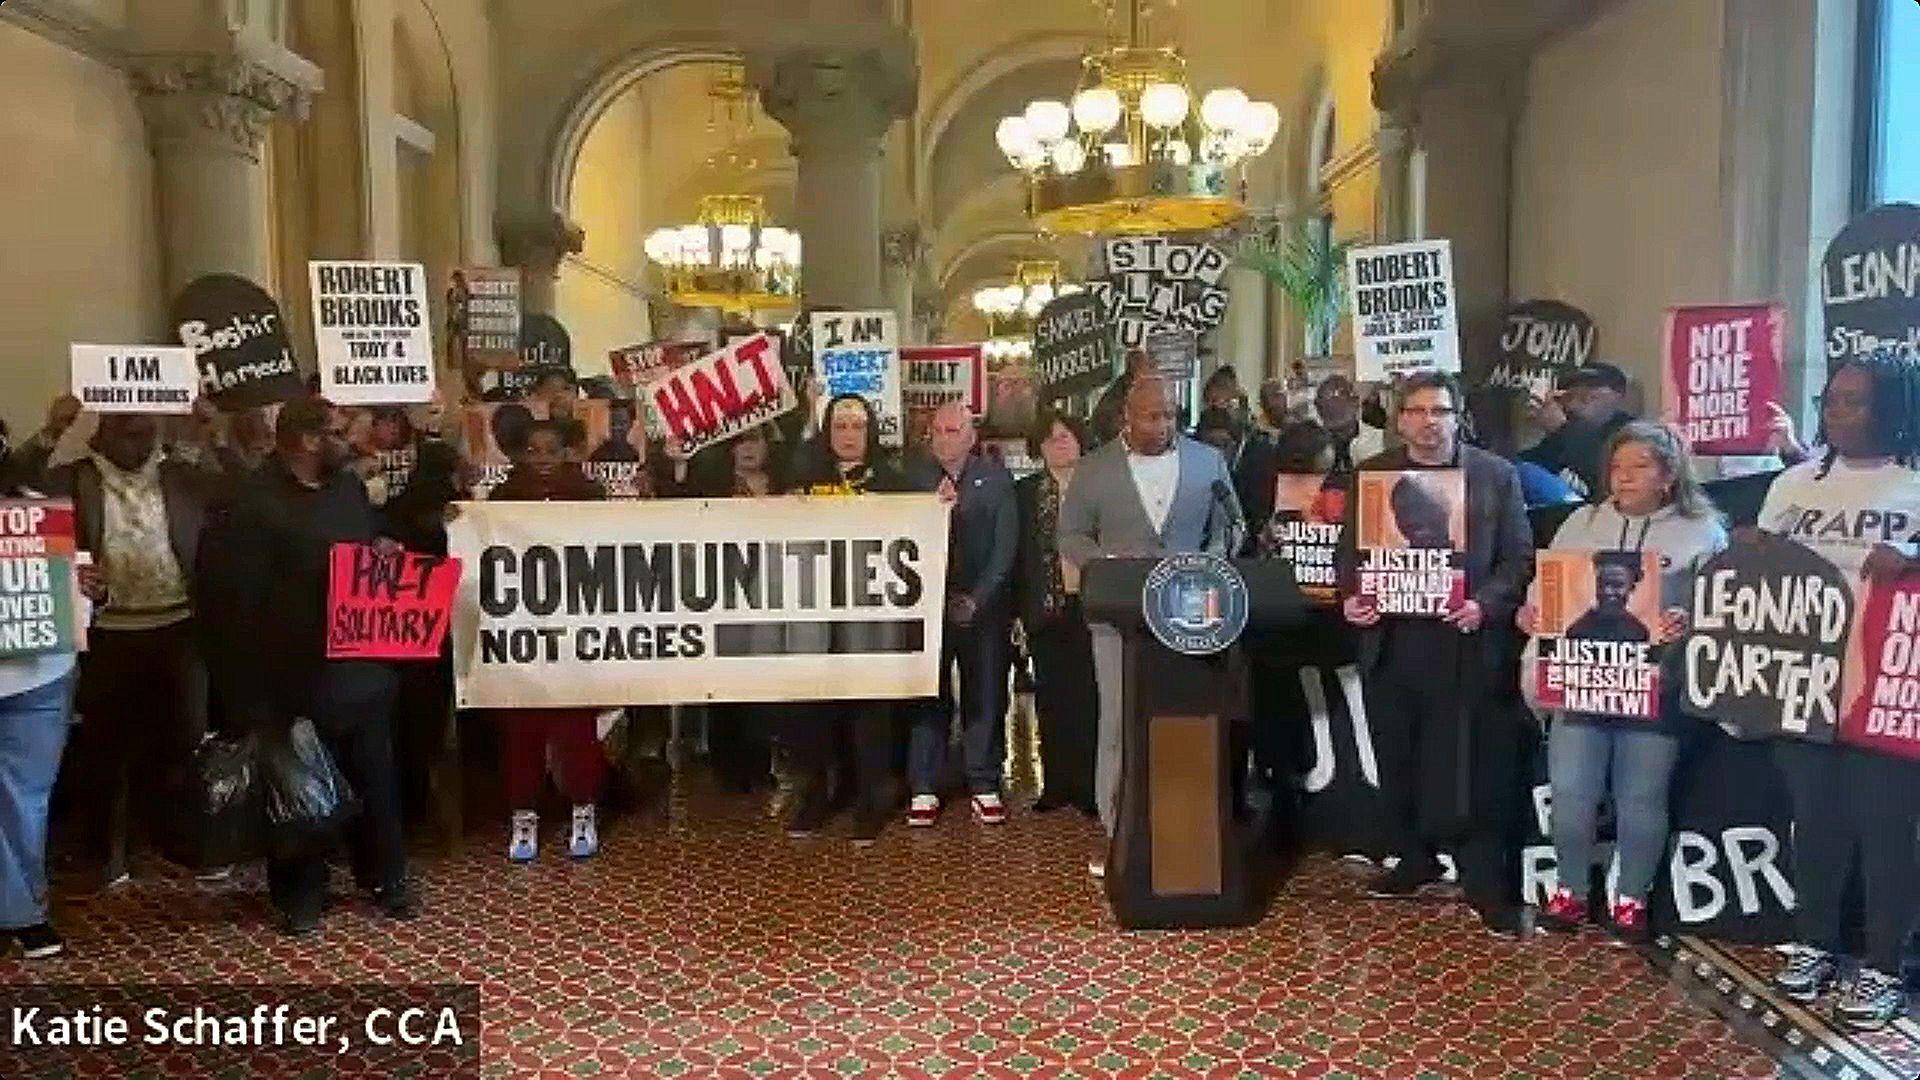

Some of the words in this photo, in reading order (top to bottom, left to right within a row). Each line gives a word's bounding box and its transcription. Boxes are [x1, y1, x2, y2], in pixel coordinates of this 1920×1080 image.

[1112, 238, 1223, 280] STOP
[1355, 248, 1441, 286] ROBERT
[319, 266, 413, 294] ROBERT
[320, 299, 421, 327] BROOKS
[1357, 280, 1448, 316] BROOKS
[179, 313, 276, 353] Bashir
[823, 318, 843, 348] I
[850, 317, 882, 342] AM
[1501, 317, 1594, 368] JOHN
[1688, 319, 1753, 358] NOT
[347, 341, 389, 359] TROY
[107, 356, 118, 381] I
[124, 356, 161, 381] AM
[332, 366, 384, 385] BLACK
[387, 366, 430, 385] LIVES
[1687, 352, 1752, 391] ONE
[83, 387, 134, 403] ROBERT
[137, 387, 190, 403] BROOKS
[1687, 391, 1750, 419] MORE
[1687, 415, 1750, 443] DEATH
[0, 506, 46, 535] TOP
[1793, 509, 1909, 541] RAPP
[0, 558, 50, 592] UR
[351, 545, 440, 602] HALT
[1357, 549, 1452, 572] JUSTICE
[480, 539, 924, 617] COMMUNITIES
[1376, 593, 1451, 614] SHOLTZ
[1692, 568, 1847, 644] LEONARD
[334, 603, 443, 647] SOLITARY
[482, 627, 566, 664] NOT
[576, 624, 707, 664] CAGES
[1549, 640, 1651, 668] JUSTICE
[1564, 664, 1651, 690] MESSIAH
[1684, 635, 1843, 733] CARTER
[1564, 690, 1650, 717] NANTWI
